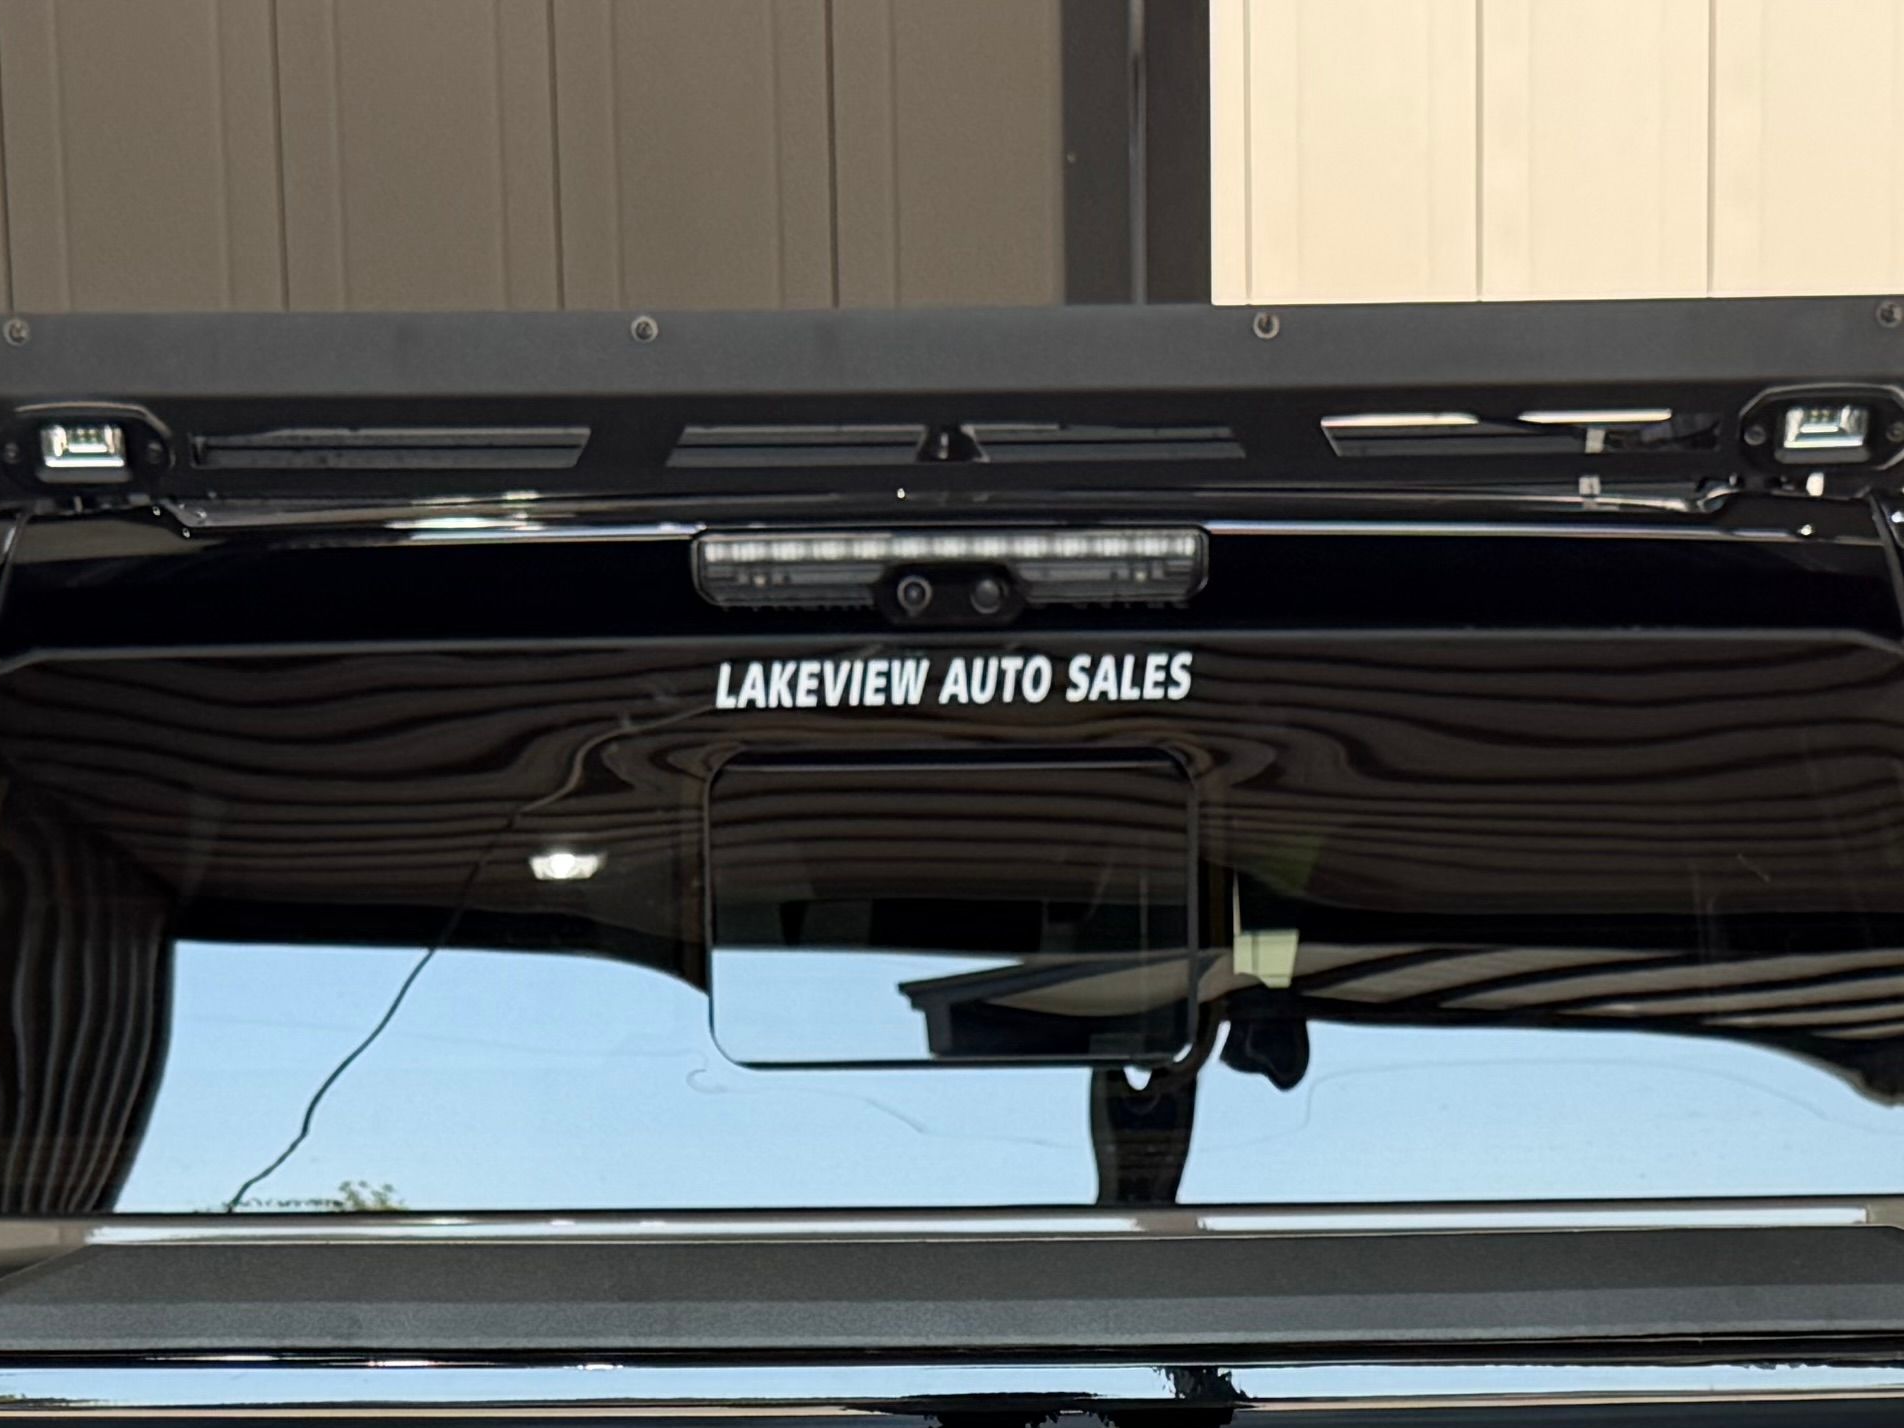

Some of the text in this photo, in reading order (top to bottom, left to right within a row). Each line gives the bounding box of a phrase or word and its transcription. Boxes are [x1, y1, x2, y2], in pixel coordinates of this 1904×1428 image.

[715, 652, 1194, 709] LAKEVIEW AUTO SALES
